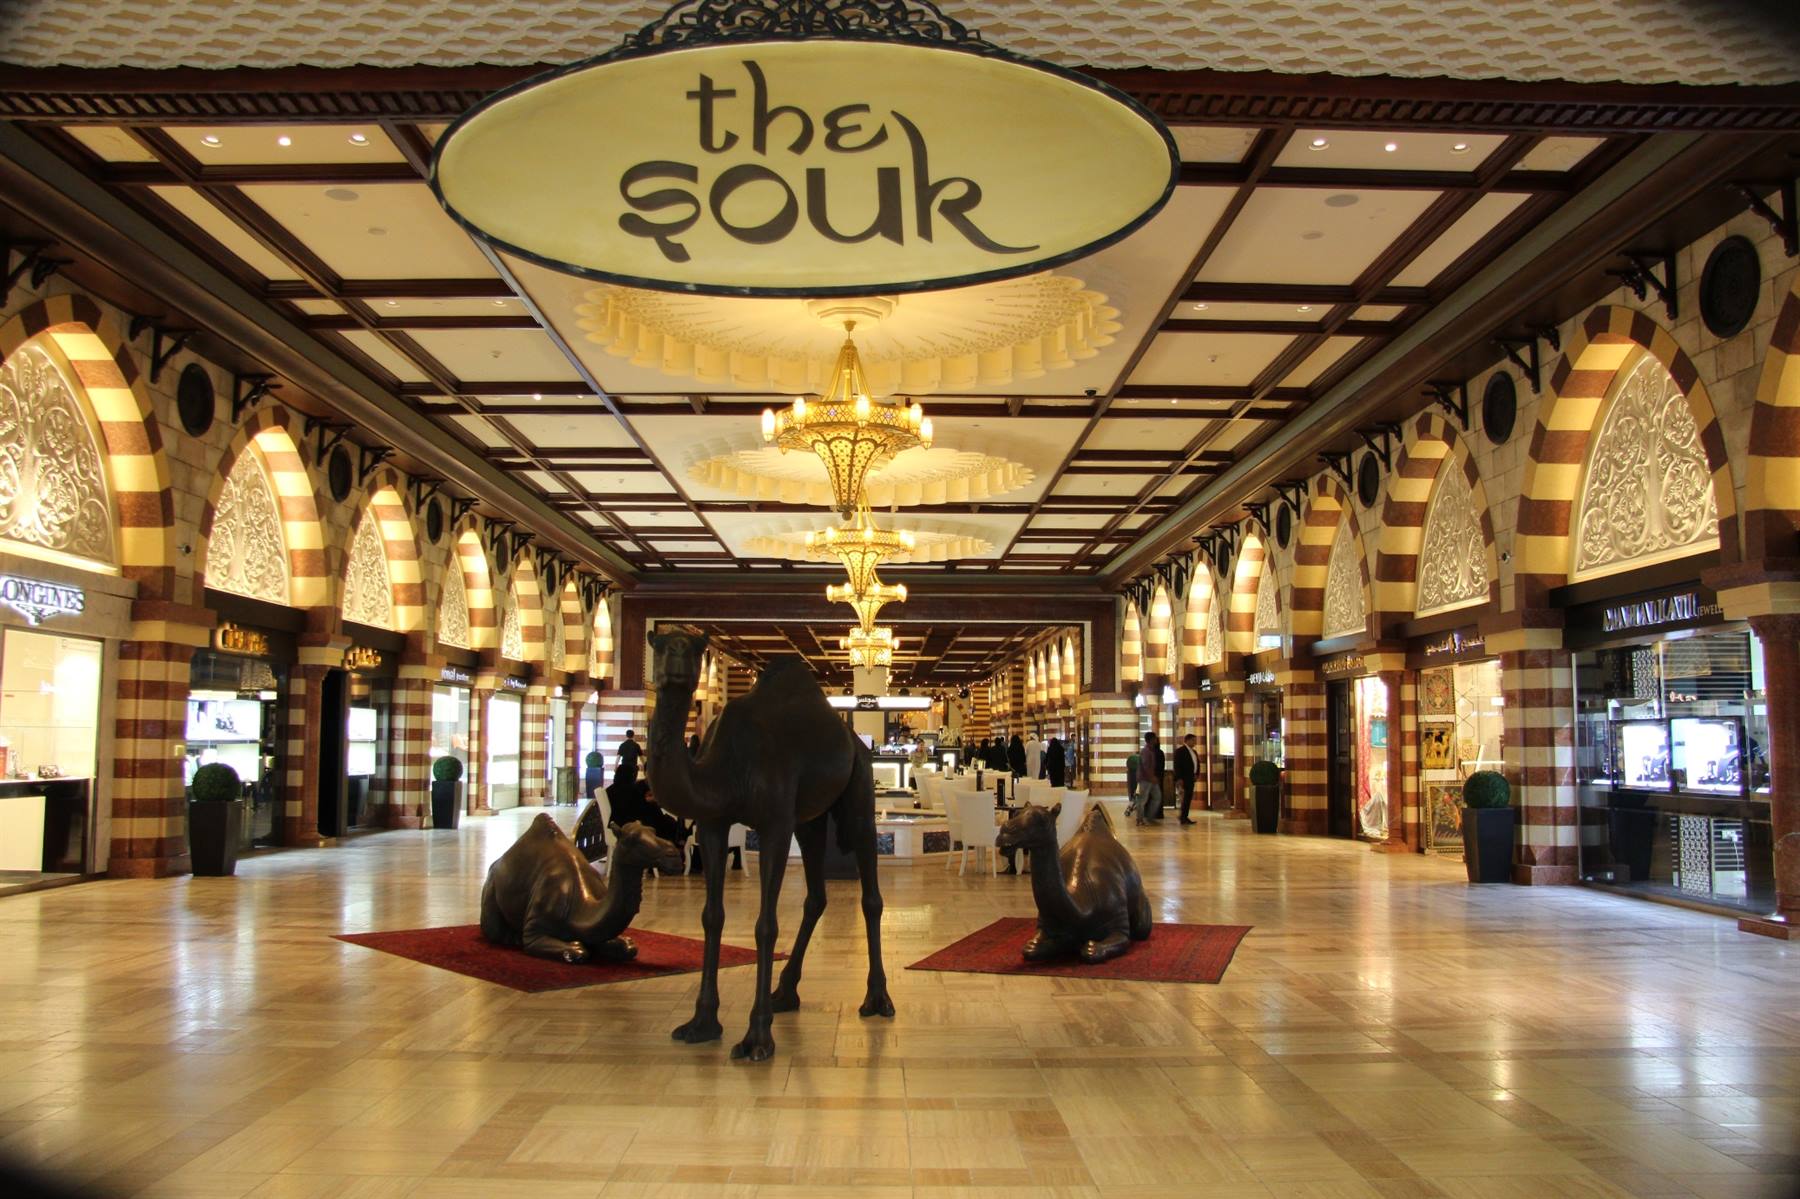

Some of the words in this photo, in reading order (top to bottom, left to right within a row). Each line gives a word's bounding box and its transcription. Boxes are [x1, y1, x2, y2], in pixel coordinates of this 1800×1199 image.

[686, 60, 889, 156] the
[0, 578, 86, 612] ONGINES
[1603, 593, 1698, 632] MAHALLATI
